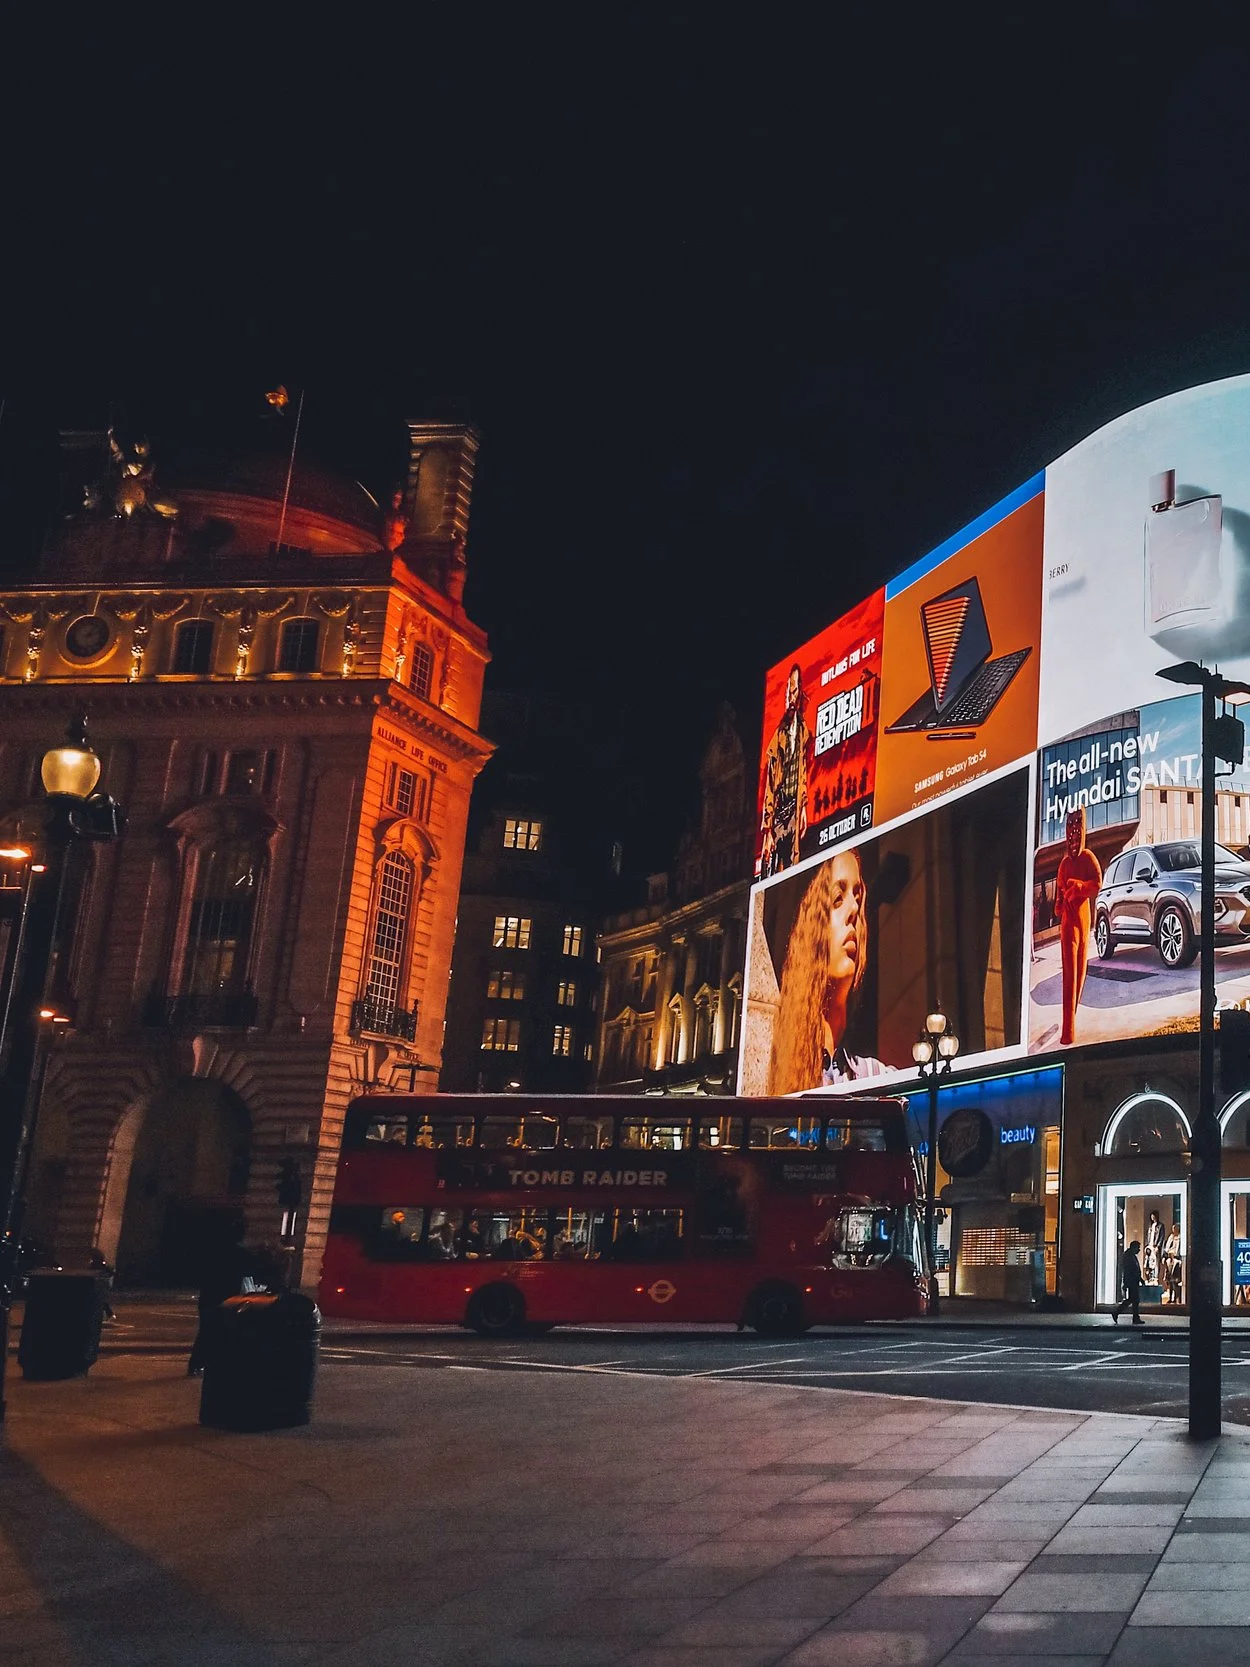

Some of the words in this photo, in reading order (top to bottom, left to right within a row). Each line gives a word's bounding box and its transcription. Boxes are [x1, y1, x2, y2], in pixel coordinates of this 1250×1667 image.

[861, 638, 876, 659] LIFE
[816, 702, 836, 737] RED
[836, 685, 864, 726] DEAD
[377, 727, 407, 750] ALLIANCE
[411, 746, 424, 760] LIFE
[428, 755, 448, 773] OFFICE
[815, 712, 862, 756] REDEMPTION
[914, 770, 944, 793] SAMSUNG
[945, 759, 968, 777] Galaxy
[967, 753, 979, 766] Tab
[1047, 757, 1077, 788] The
[1079, 731, 1160, 773] all-new
[1045, 769, 1121, 823] Hyundai
[1126, 753, 1203, 794] SANT
[819, 828, 829, 845] 26
[829, 814, 856, 840] OCTOBER
[1001, 1124, 1036, 1144] beauty
[508, 1170, 575, 1185] TOMB
[582, 1170, 669, 1186] RAIDER
